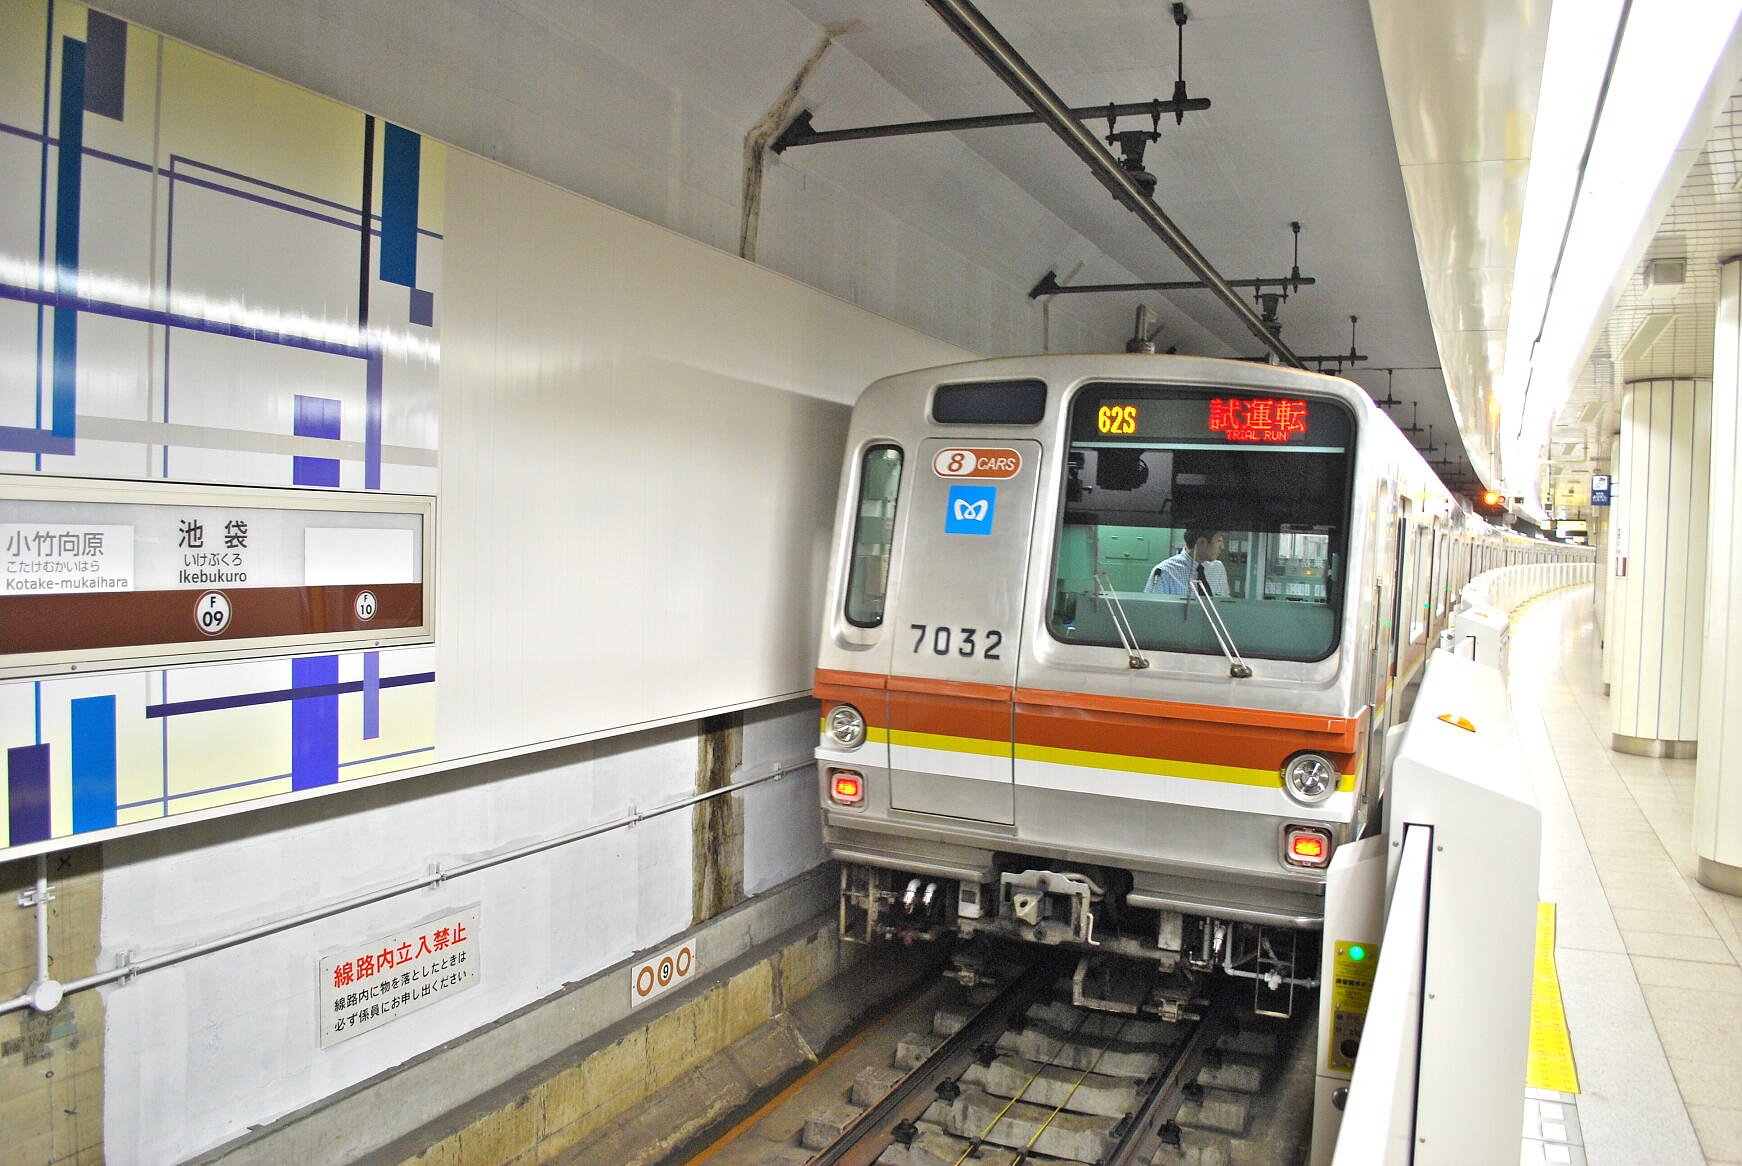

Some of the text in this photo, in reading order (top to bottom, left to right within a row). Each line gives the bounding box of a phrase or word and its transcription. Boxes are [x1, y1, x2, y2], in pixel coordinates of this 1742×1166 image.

[1098, 406, 1137, 434] 62S
[1209, 399, 1307, 432] 試運転
[1226, 429, 1287, 440] TRIAL RUN
[947, 453, 1016, 472] 8 CARS
[178, 519, 248, 549] 池袋
[6, 530, 104, 557] 小竹向原
[7, 560, 100, 573] こたけむかいはら
[184, 553, 242, 567] いけぶくろ
[6, 576, 128, 591] Kotake-mukaihara
[179, 569, 247, 584] Ikebukuro
[210, 596, 216, 608] F
[363, 594, 368, 603] F
[360, 604, 373, 615] 10
[202, 610, 224, 627] 09
[910, 624, 1003, 660] 7032
[334, 922, 468, 989] 線路内立入禁止
[334, 950, 467, 1013] 線路内に物を落としたときは
